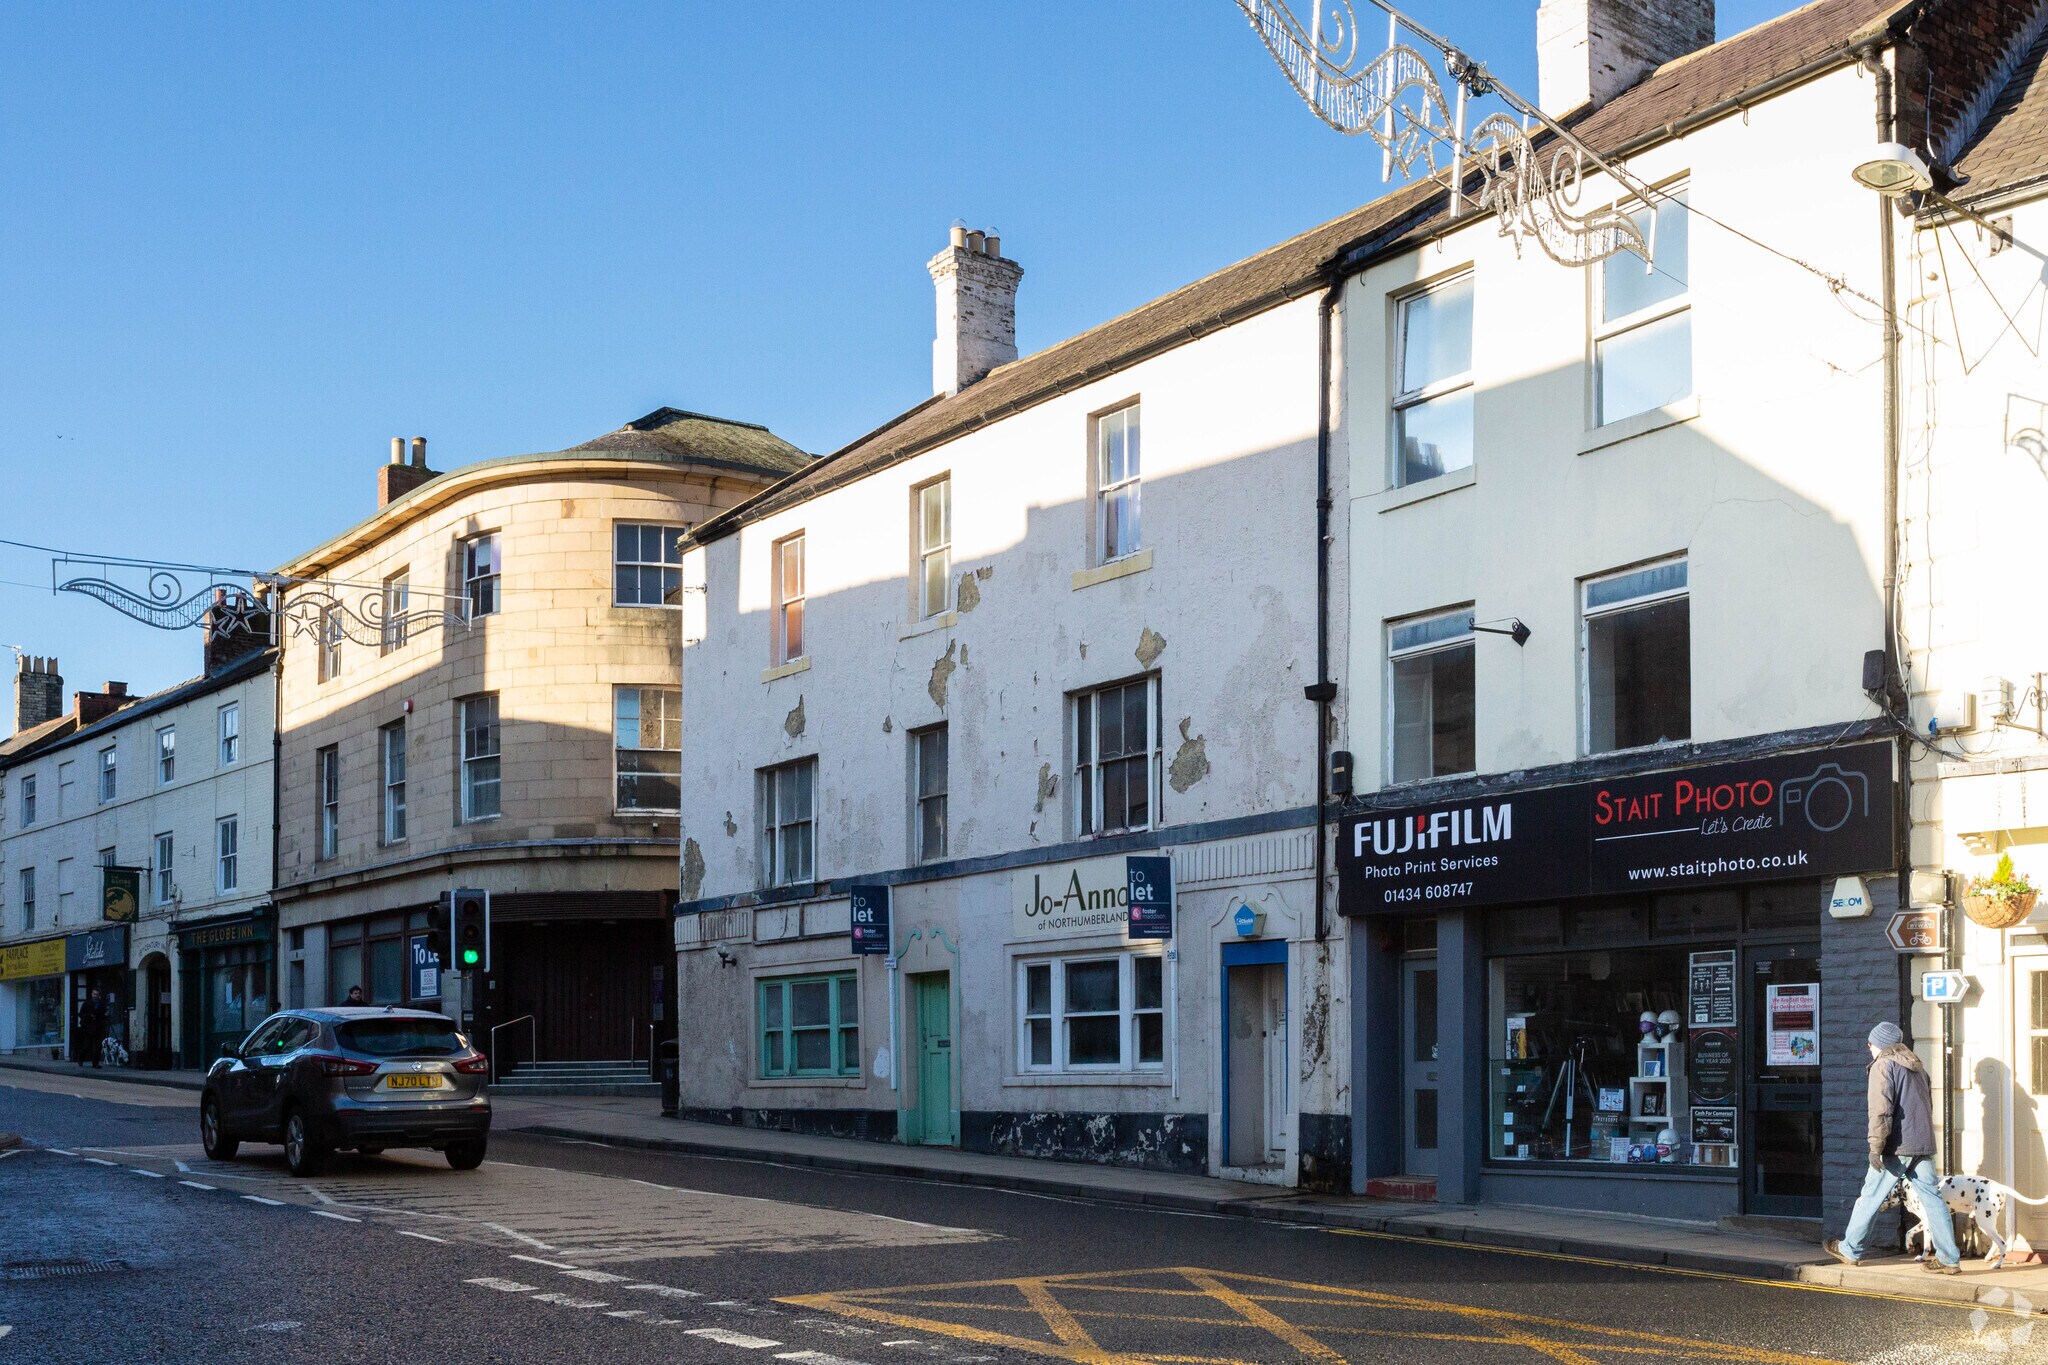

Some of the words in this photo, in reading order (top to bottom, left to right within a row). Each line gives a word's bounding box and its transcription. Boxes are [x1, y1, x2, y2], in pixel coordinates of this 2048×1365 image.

[1354, 803, 1512, 857] FUJIFILM
[1700, 816, 1728, 836] Let's
[1731, 812, 1773, 833] Create
[1365, 865, 1401, 879] Photo
[1405, 861, 1436, 875] Print
[1440, 855, 1499, 871] Services
[1628, 850, 1809, 880] www.staitphoto.co.uk
[1130, 869, 1145, 882] to
[853, 895, 867, 907] to
[1130, 882, 1154, 901] let
[1384, 887, 1421, 903] 01434
[1425, 882, 1474, 899] 608747
[1833, 897, 1862, 907] SECOM
[853, 907, 874, 922] let
[1038, 919, 1047, 931] of
[1048, 911, 1129, 929] NORTHUMBERLAND
[191, 931, 208, 945] THE
[210, 927, 237, 942] GLOBE
[238, 925, 254, 939] INN
[1931, 978, 1944, 995] P
[391, 1075, 417, 1086] NJ70
